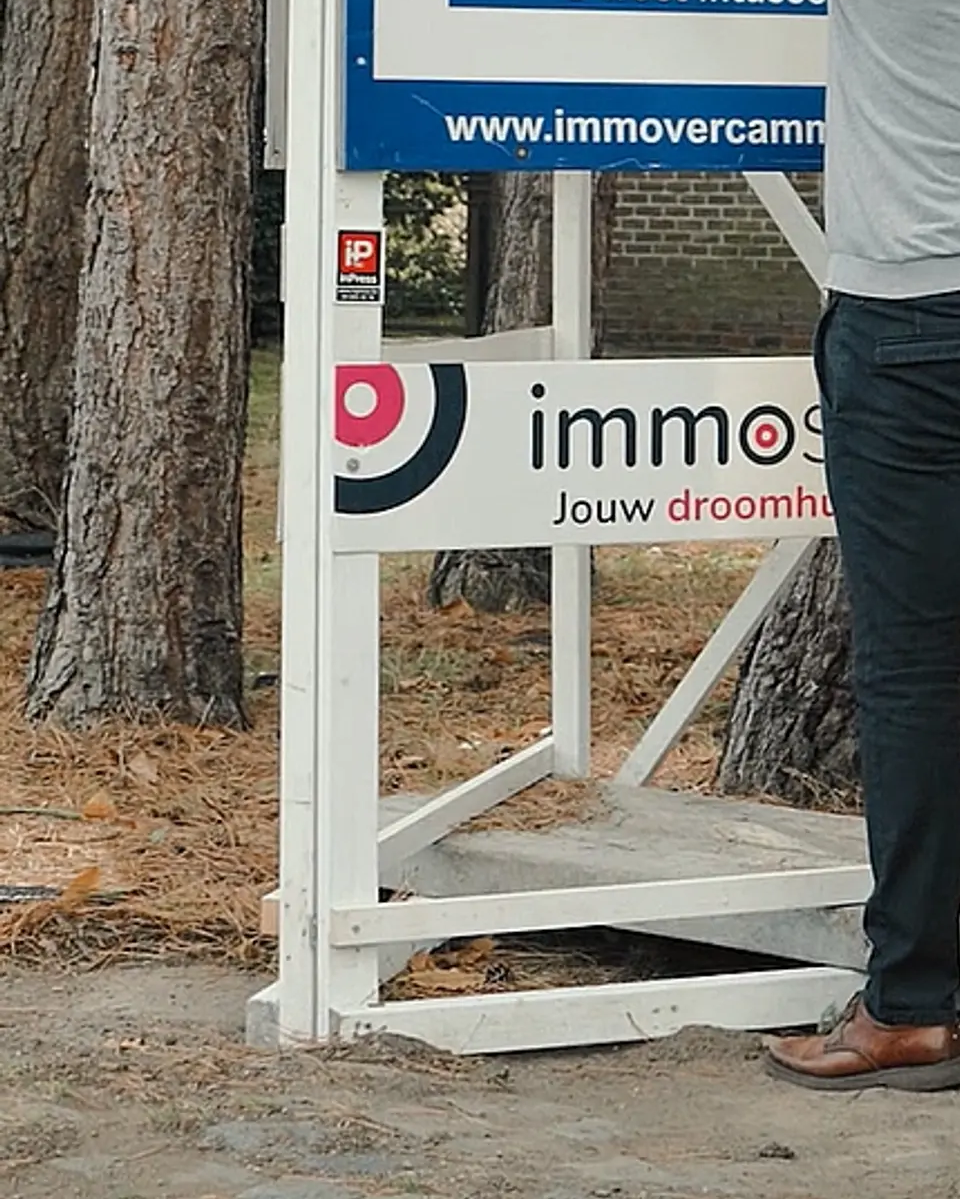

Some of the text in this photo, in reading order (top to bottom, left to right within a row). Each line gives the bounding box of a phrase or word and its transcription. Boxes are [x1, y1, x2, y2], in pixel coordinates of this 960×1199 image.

[445, 108, 826, 145] www.immovercamm
[552, 490, 655, 526] Jouw
[668, 485, 835, 522] droomhu
